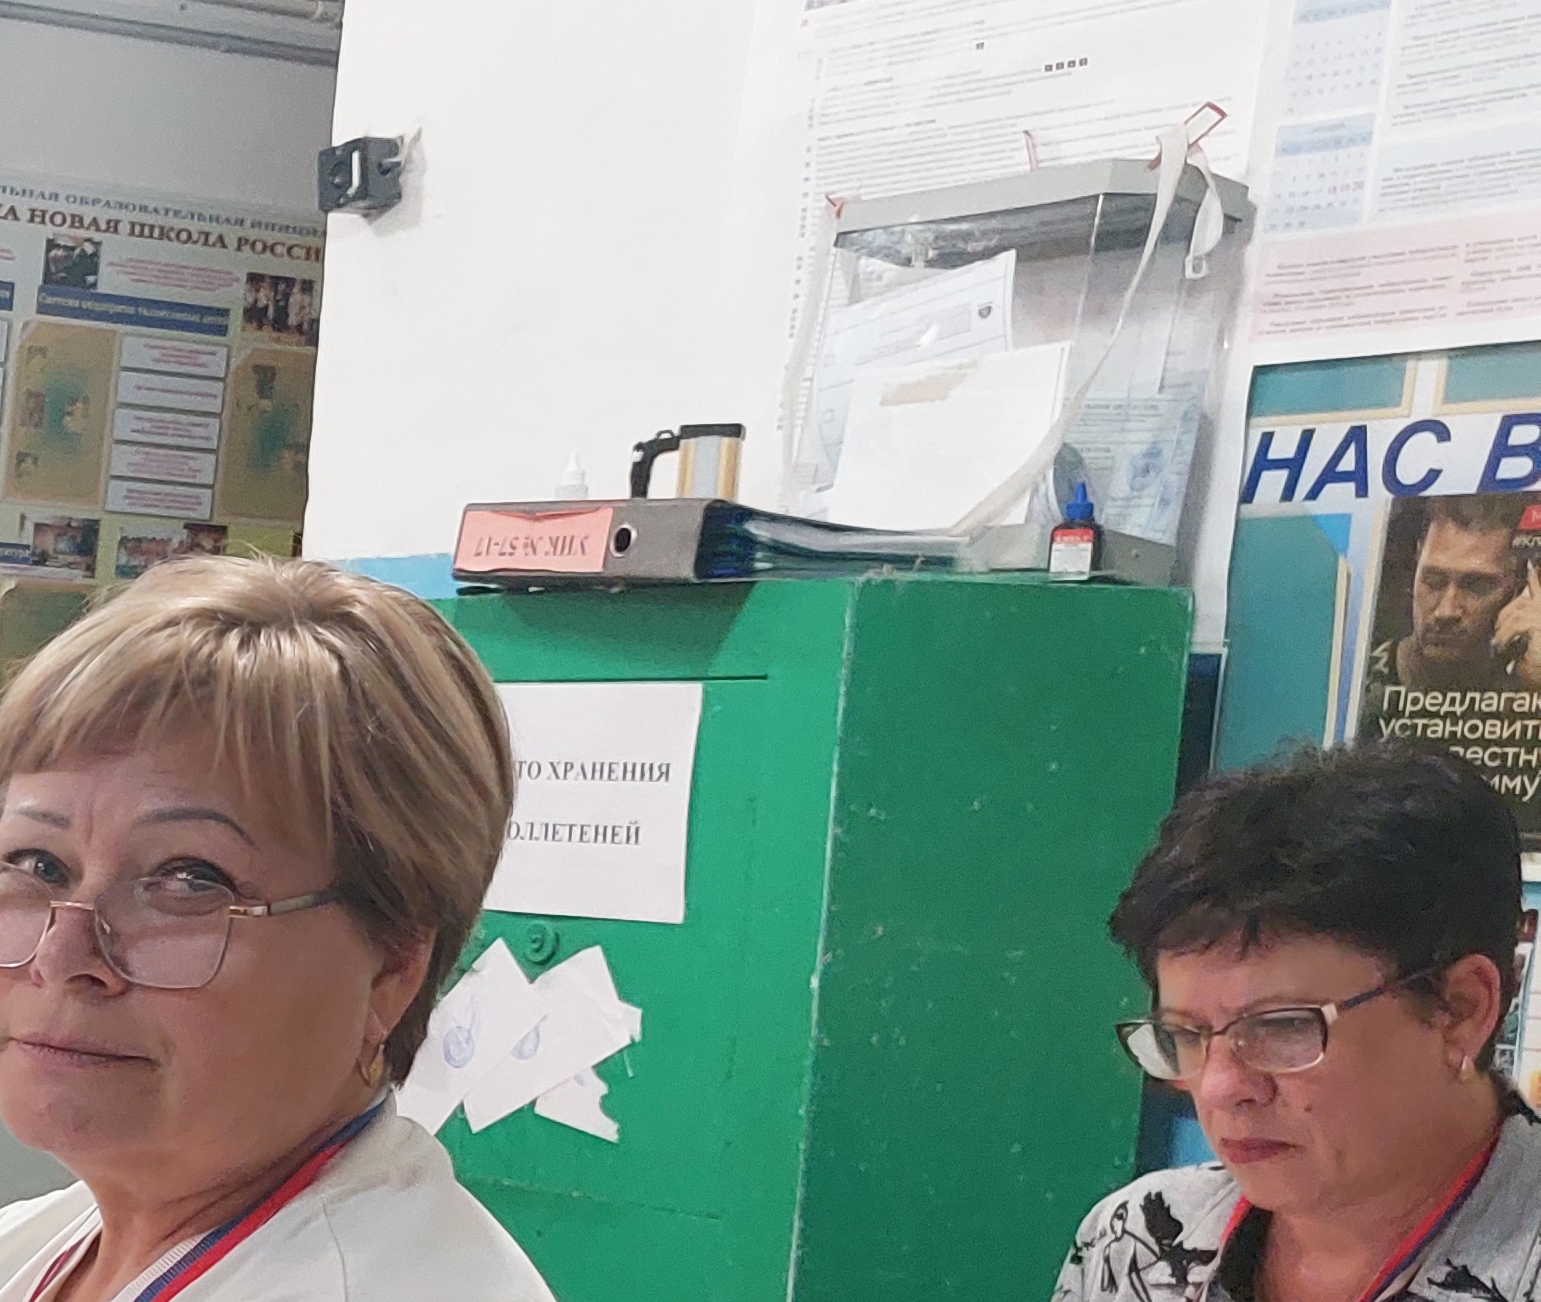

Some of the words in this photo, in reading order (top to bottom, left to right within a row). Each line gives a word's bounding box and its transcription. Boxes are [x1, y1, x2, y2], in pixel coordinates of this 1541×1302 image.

[27, 209, 118, 235] НОВАЯ
[127, 221, 228, 250] ШКОЛА
[1240, 418, 1451, 504] НАС
[473, 535, 519, 557] 57-17
[547, 760, 672, 783] ХРАНЕНИЯ
